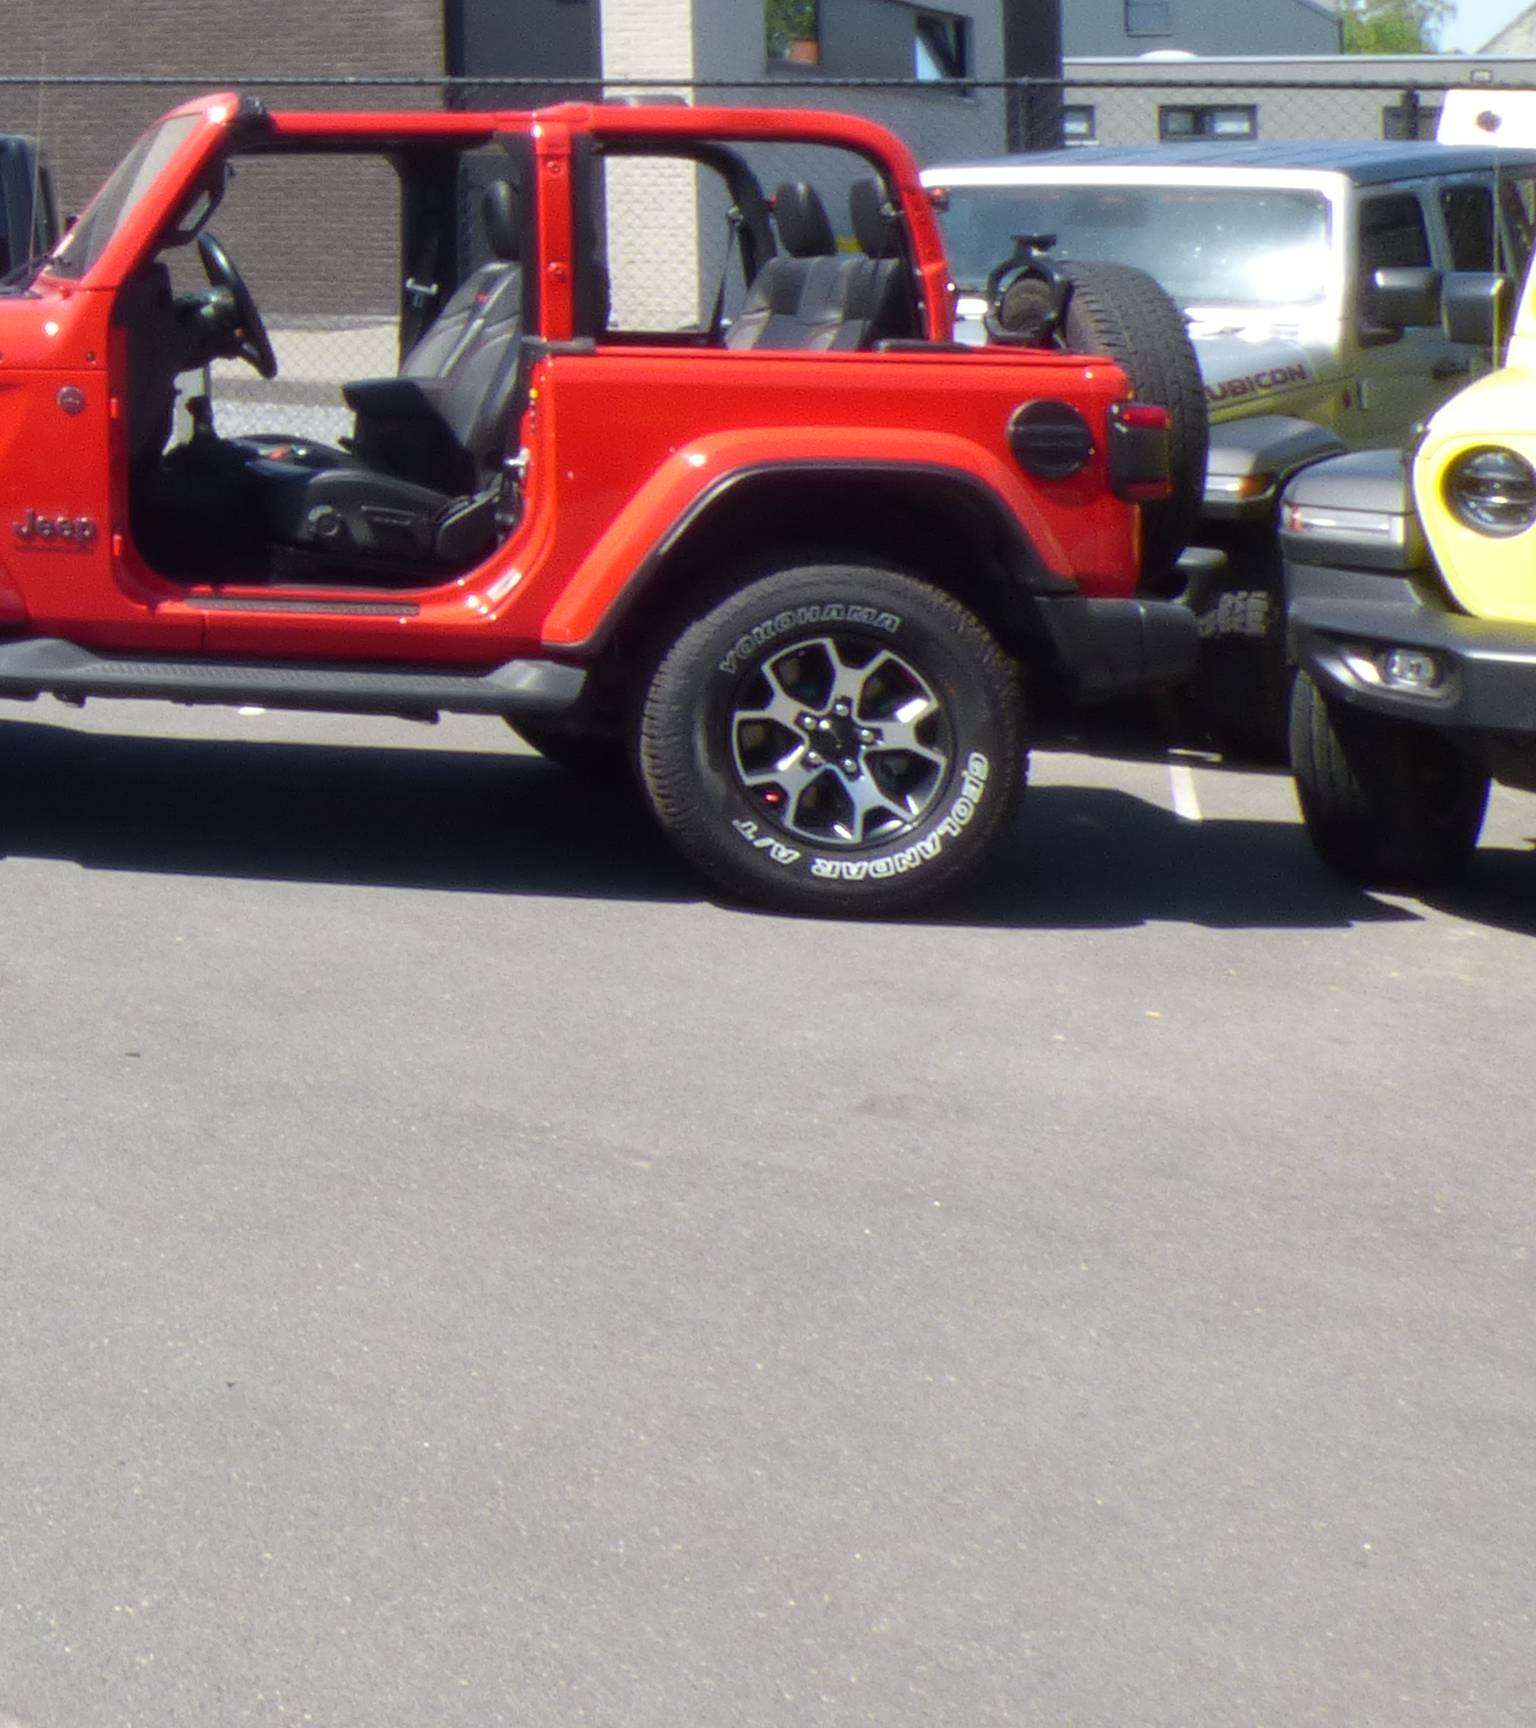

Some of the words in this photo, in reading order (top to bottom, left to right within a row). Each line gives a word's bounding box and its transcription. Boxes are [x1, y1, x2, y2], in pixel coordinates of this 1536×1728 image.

[1203, 364, 1307, 400] UBICON
[12, 509, 96, 543] Jeep
[719, 603, 903, 674] YOKOHAMA
[810, 752, 990, 880] GEOLANDAR
[732, 817, 800, 866] A/T
